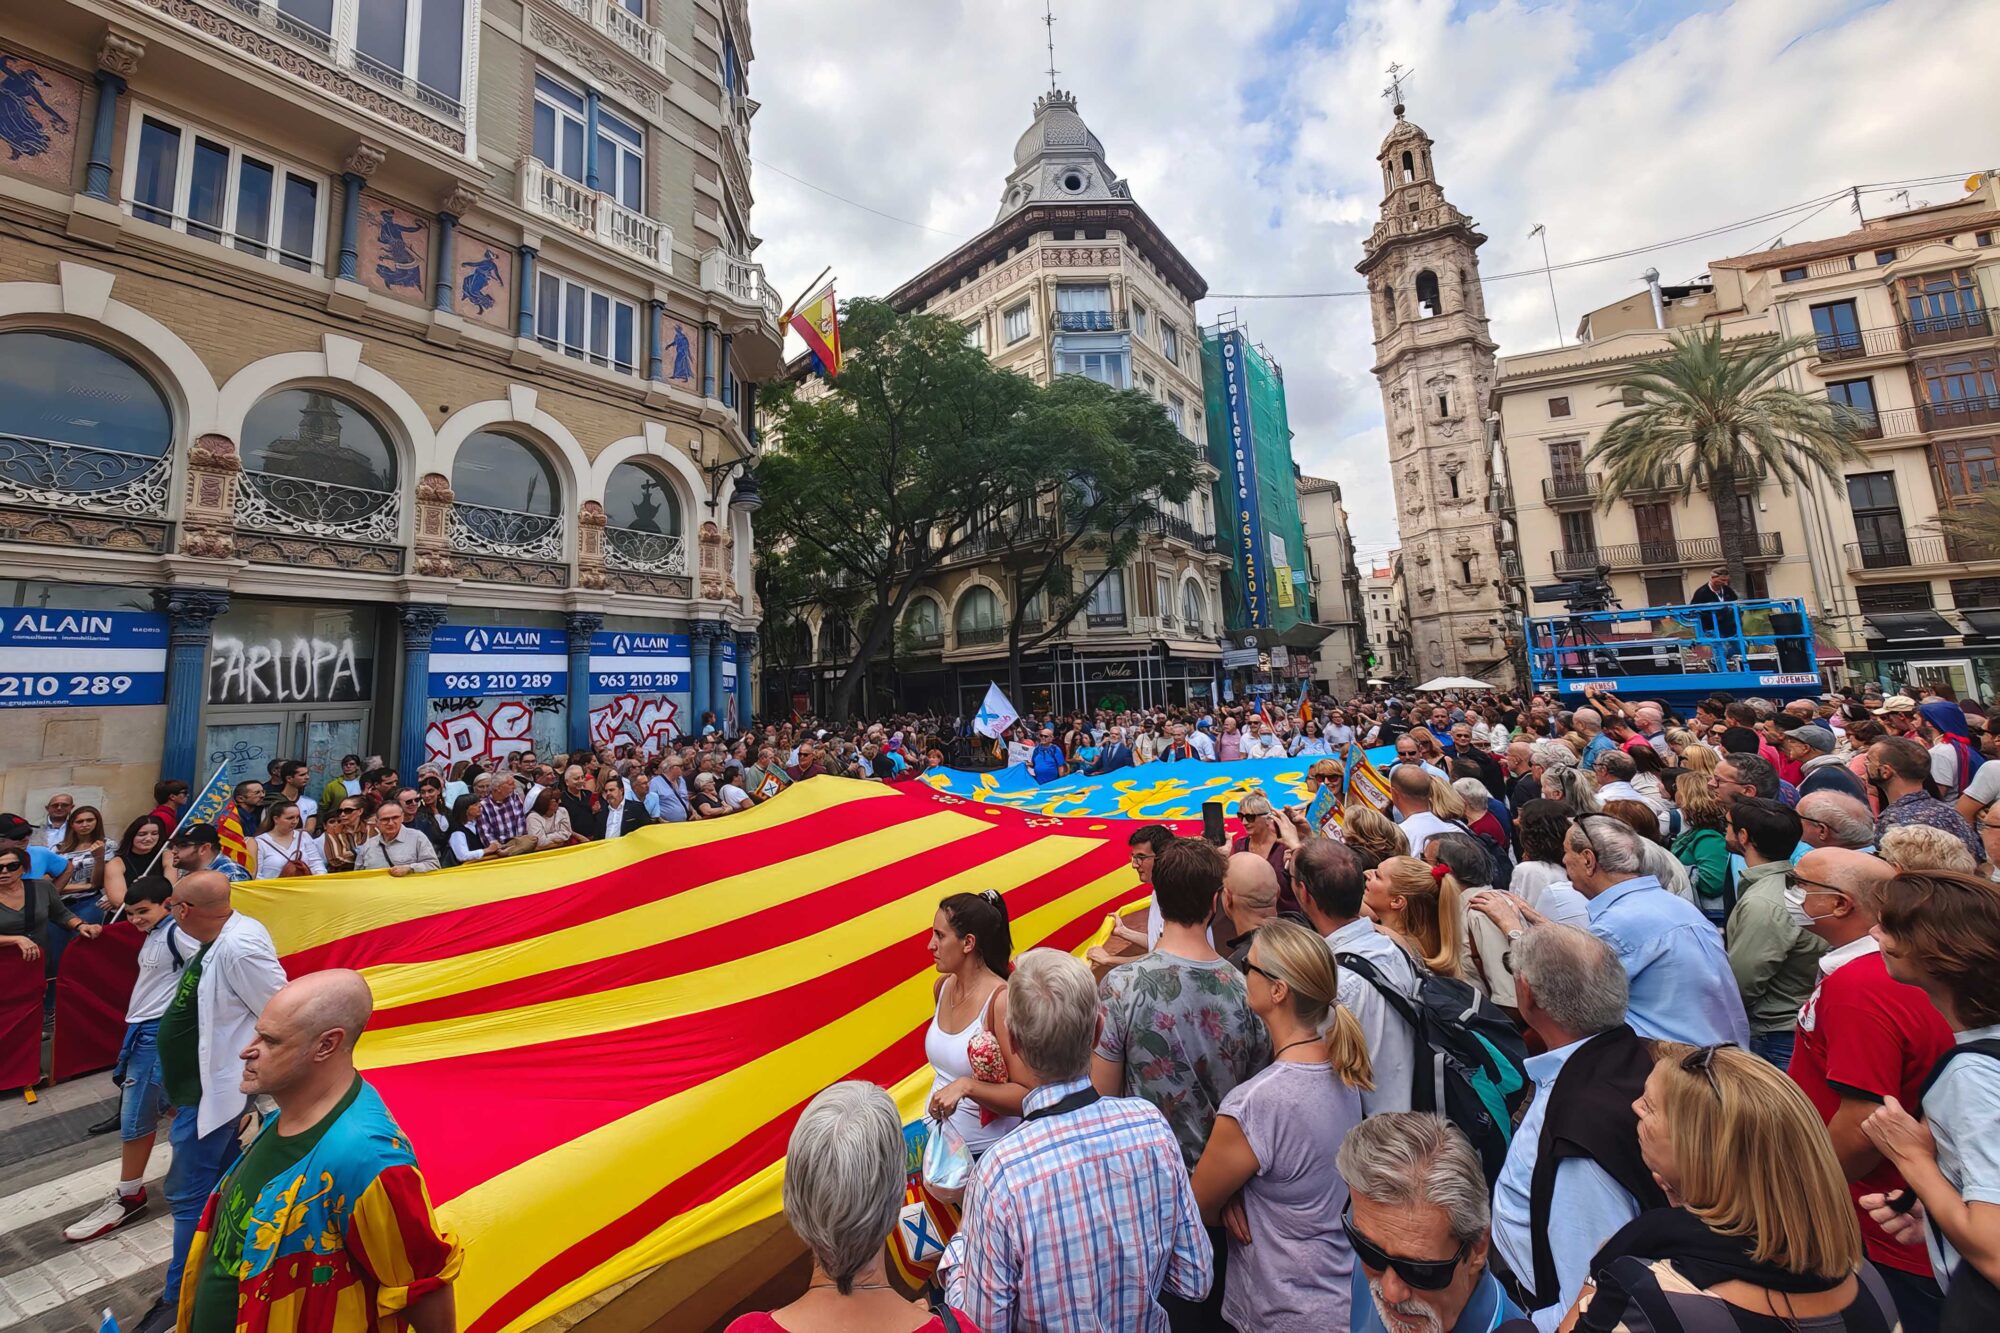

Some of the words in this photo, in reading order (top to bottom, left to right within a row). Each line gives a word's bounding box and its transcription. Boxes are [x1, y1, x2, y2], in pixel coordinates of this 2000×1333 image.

[13, 614, 113, 634] ALAIN
[492, 631, 541, 645] ALAIN
[633, 637, 669, 649] ALAIN
[1091, 662, 1133, 680] Nela
[0, 676, 59, 696] 210
[69, 676, 132, 696] 289
[445, 674, 481, 689] 963
[487, 674, 517, 689] 210
[521, 674, 552, 688] 289
[599, 674, 625, 687] 963
[630, 674, 652, 687] 210
[655, 674, 679, 686] 289
[1776, 674, 1816, 684] JOFEMESA
